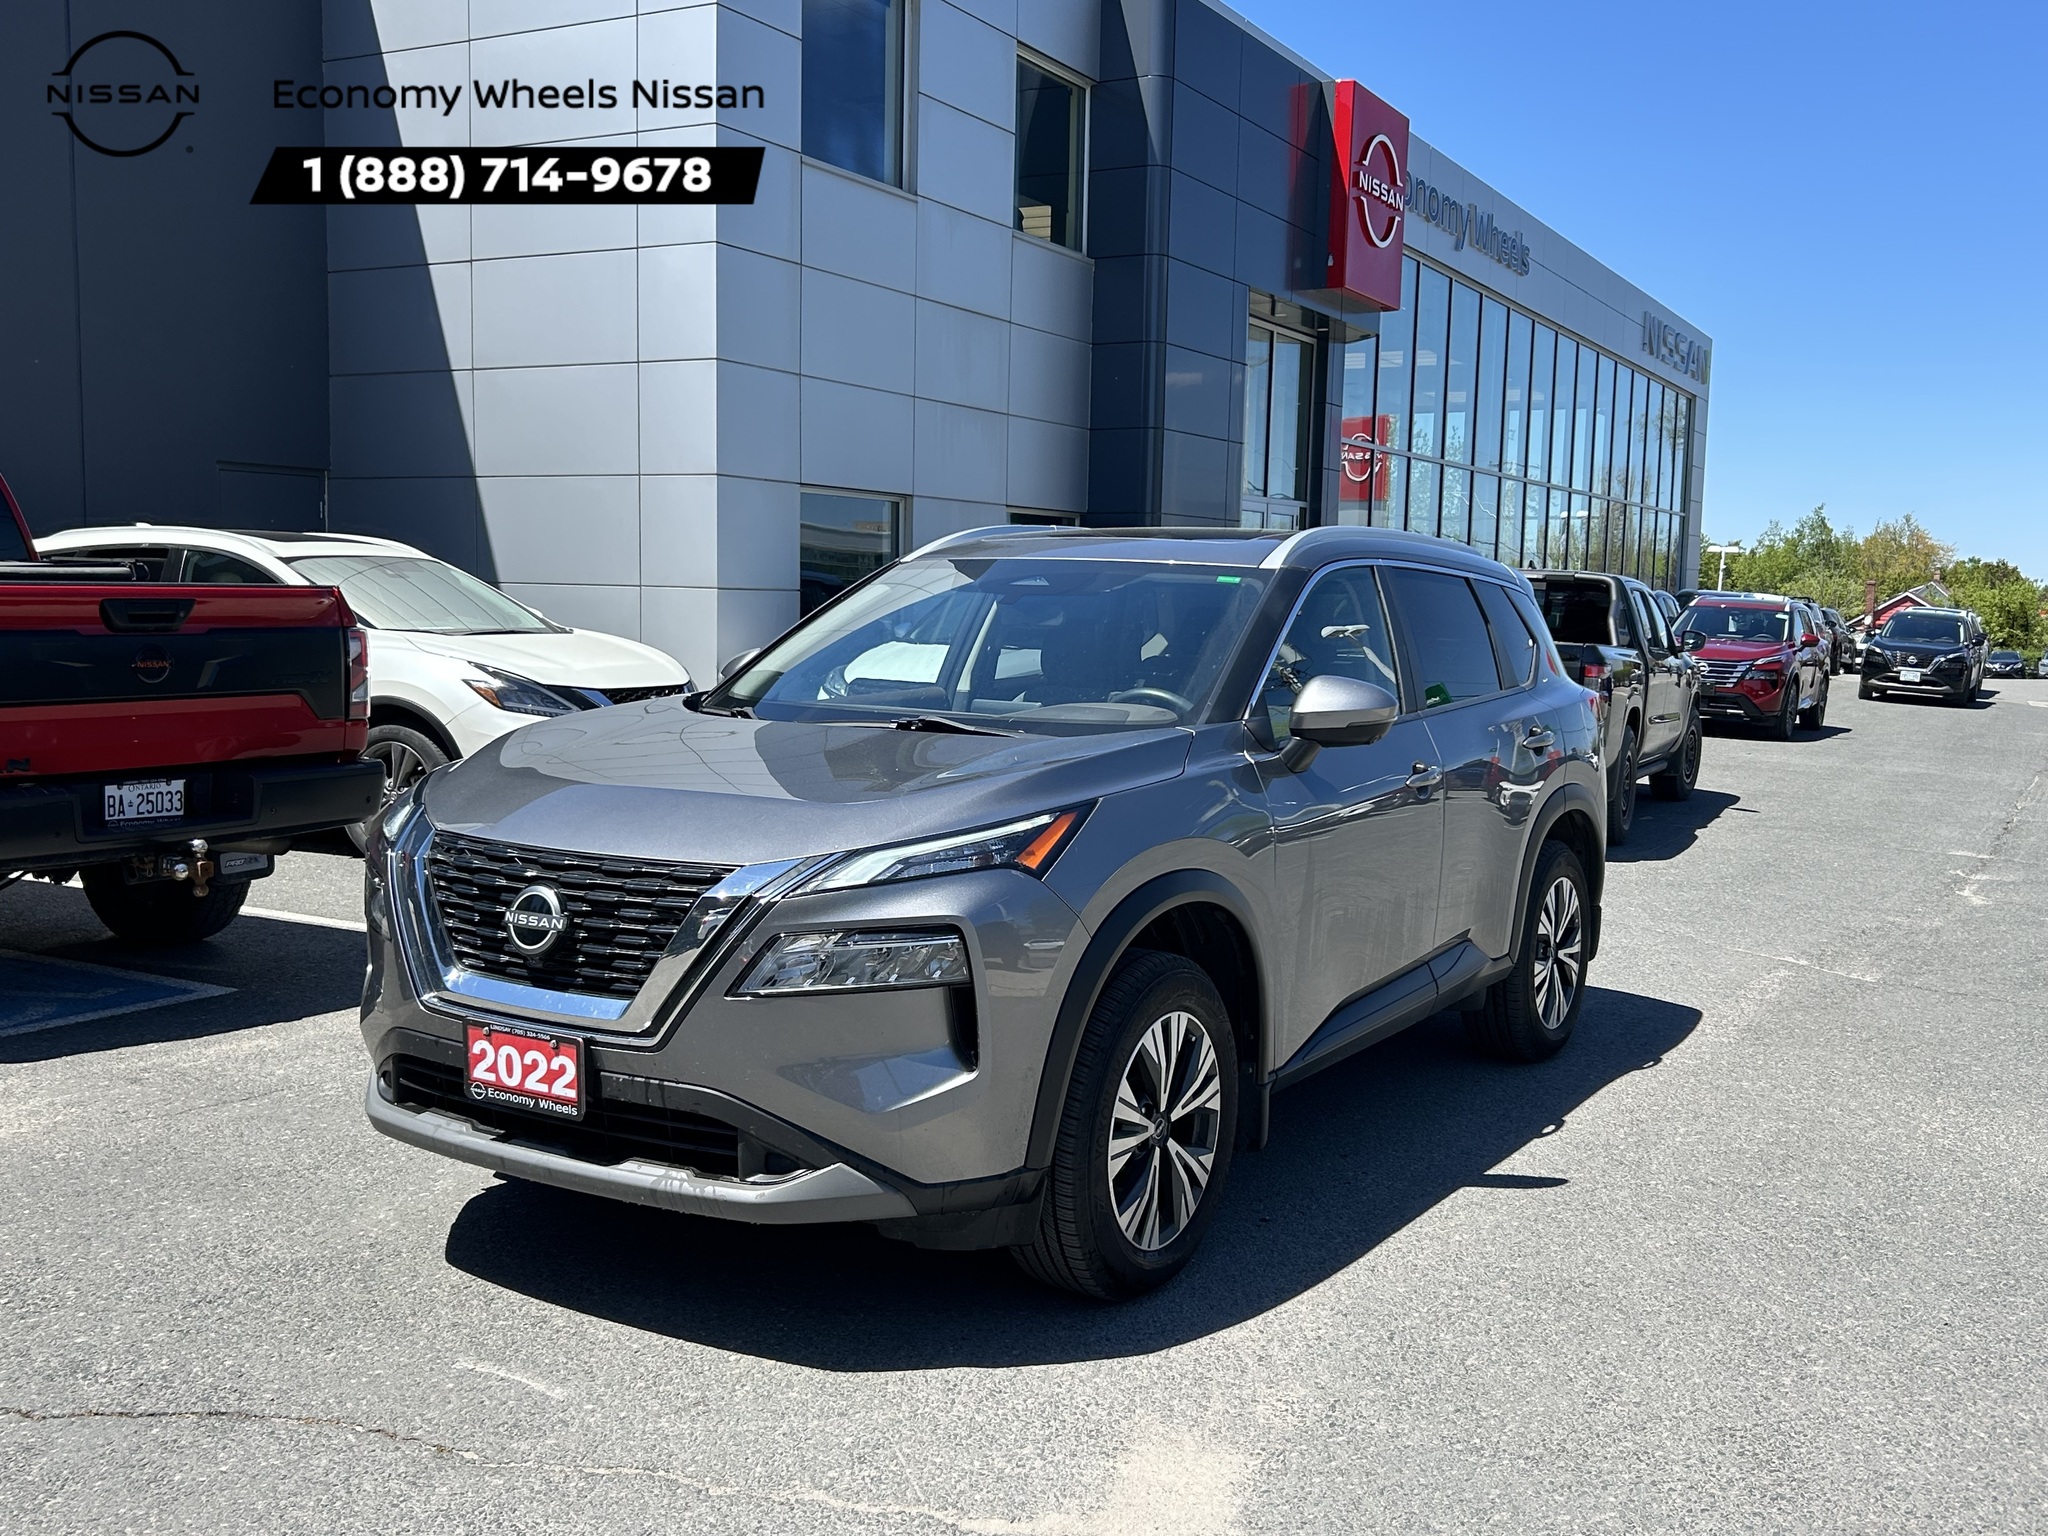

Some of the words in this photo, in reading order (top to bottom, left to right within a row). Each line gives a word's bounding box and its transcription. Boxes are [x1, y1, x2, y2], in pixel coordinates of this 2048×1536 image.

[1360, 170, 1404, 211] NISSAN
[1471, 203, 1531, 276] Wheels
[1642, 311, 1709, 385] NISSAN
[107, 794, 126, 817] BA
[136, 790, 183, 815] 25033
[128, 782, 161, 792] ONTARIO
[505, 911, 563, 929] NISSAN
[472, 1039, 577, 1098] 2022
[487, 1087, 535, 1108] Economy
[538, 1098, 578, 1116] Wheels
